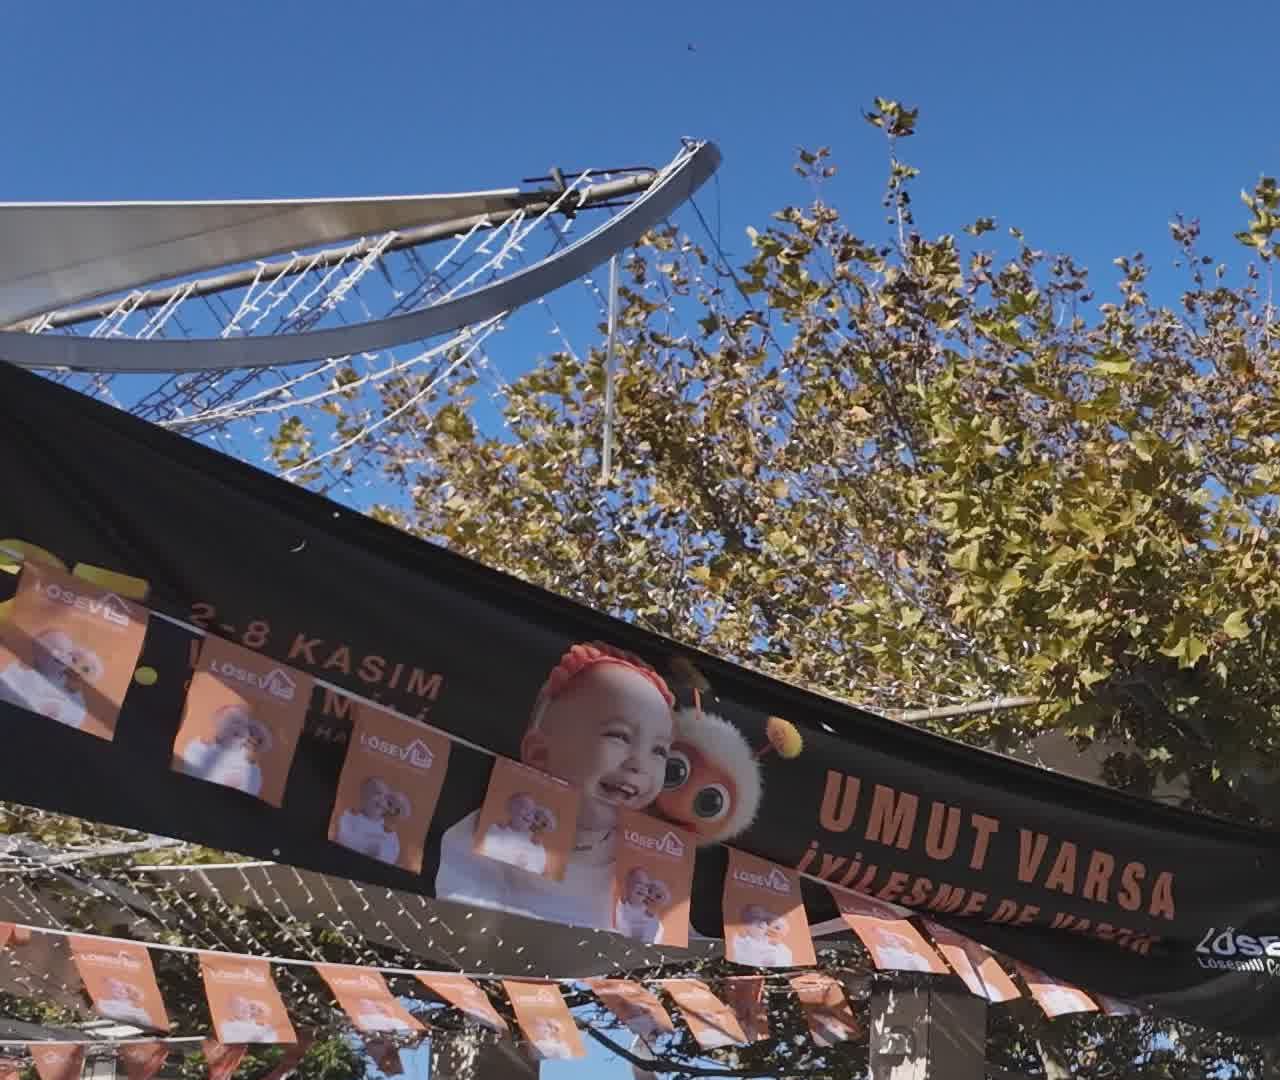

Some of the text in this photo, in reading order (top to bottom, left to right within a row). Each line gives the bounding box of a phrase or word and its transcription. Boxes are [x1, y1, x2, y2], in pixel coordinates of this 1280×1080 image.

[287, 631, 445, 700] KASIM
[819, 769, 1176, 921] UMUT VARSA
